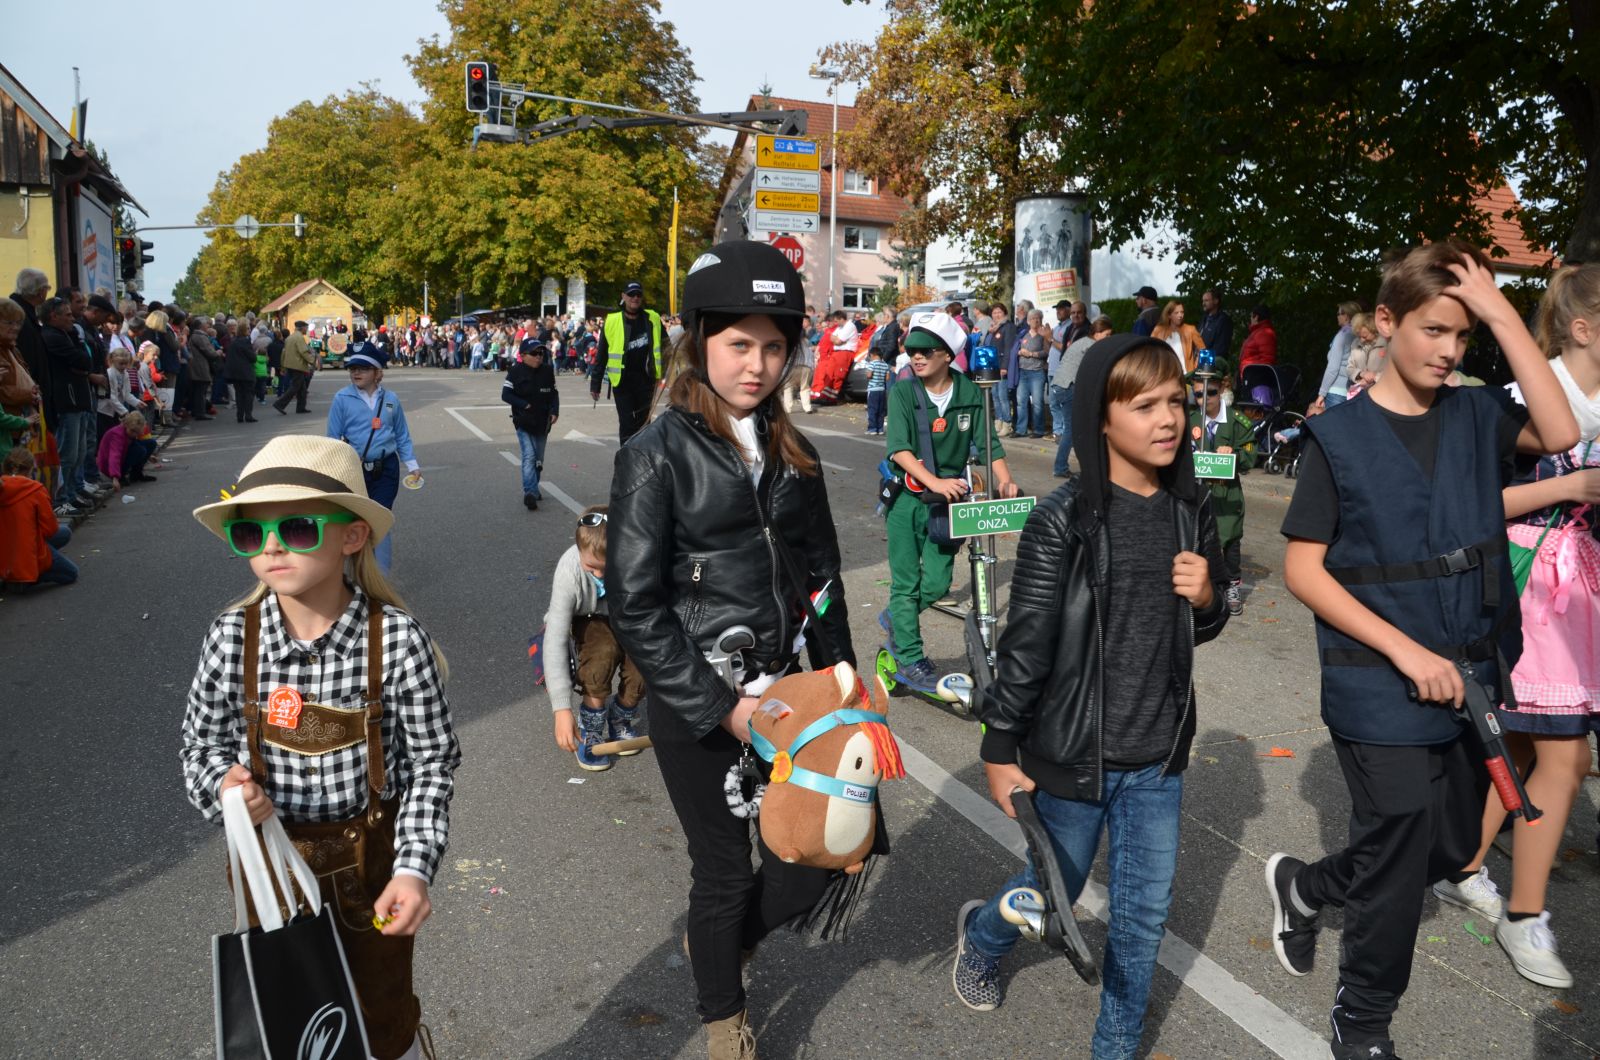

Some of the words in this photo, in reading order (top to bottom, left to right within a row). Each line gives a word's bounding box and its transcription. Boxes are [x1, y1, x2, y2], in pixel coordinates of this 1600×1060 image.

[1197, 456, 1231, 465] POLIZEI
[1195, 465, 1213, 474] NZA
[958, 506, 984, 519] CITY
[988, 502, 1031, 516] POLIZEI
[977, 518, 1009, 530] ONZA
[846, 787, 868, 798] POLIZEI
